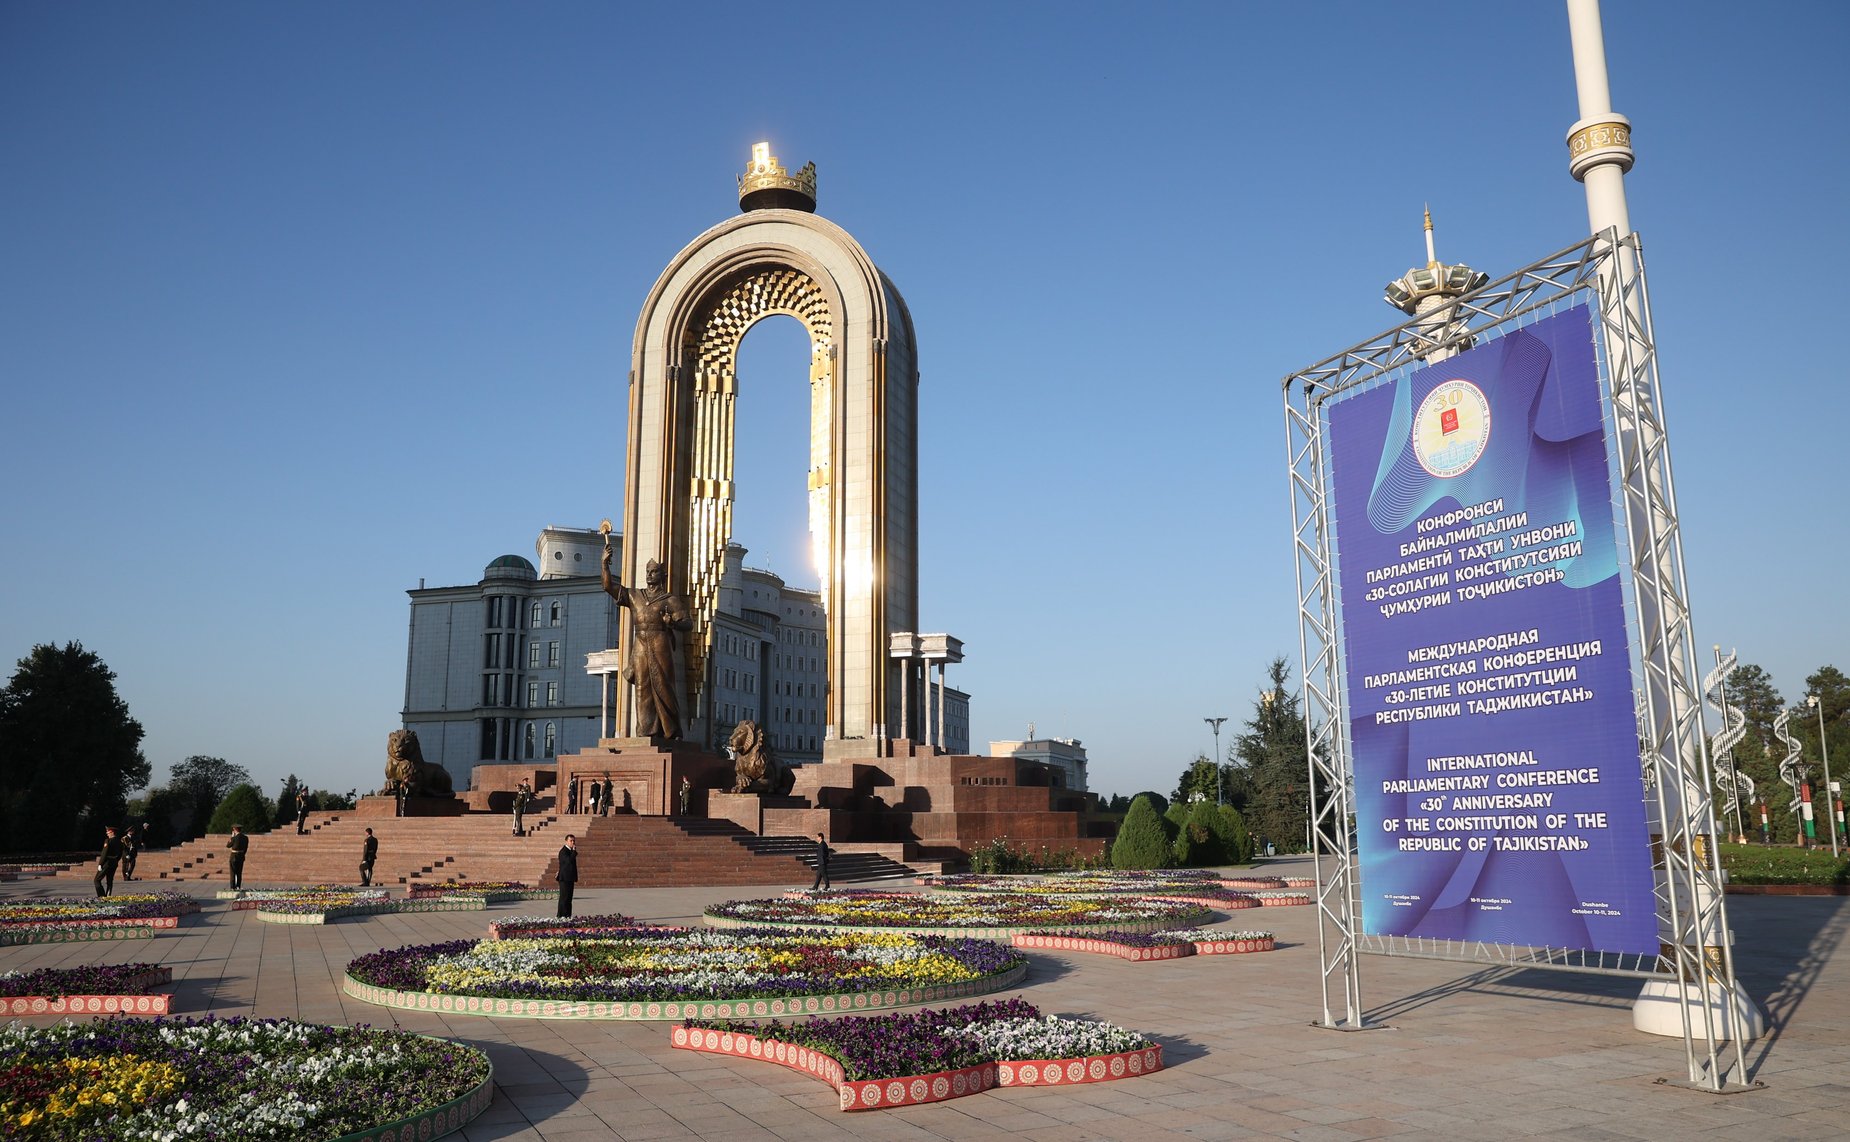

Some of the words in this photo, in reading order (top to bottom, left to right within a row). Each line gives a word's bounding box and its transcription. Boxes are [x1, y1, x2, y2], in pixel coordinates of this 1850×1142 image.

[1433, 389, 1463, 412] 30
[1417, 498, 1504, 534] КОНФРОНСИ
[1366, 549, 1453, 584] ПАРЛАМЕНТӢ
[1458, 538, 1504, 561] ТАҲТИ
[1510, 520, 1576, 551] УНВОНИ
[1400, 512, 1528, 557] БАЙНАЛМИЛАЛИИ
[1365, 571, 1449, 602] «30-СОЛАГИИ
[1455, 541, 1582, 583] КОНСТИТУТСИЯИ
[1380, 591, 1451, 619] ҶУМҲУРИИ
[1456, 568, 1565, 602] ТОҶИКИСТОН»
[1407, 628, 1539, 664] МЕЖДУНАРОДНАЯ
[1364, 659, 1477, 689] ПАРЛАМЕНТСКАЯ
[1483, 640, 1602, 672] КОНФЕРЕНЦИЯ
[1384, 683, 1452, 705] «30-ЛЕТИЕ
[1457, 666, 1577, 696] КОНСТИТУТЦИИ
[1375, 702, 1461, 725] РЕСПУБЛИКИ
[1466, 687, 1594, 715] ТАДЖИКИСТАН»
[1427, 750, 1538, 772] INTERNATIONAL
[1382, 775, 1490, 794] PARLIAMENTARY
[1496, 768, 1600, 788] CONFERENCE
[1452, 793, 1553, 811] ANNIVERSARY
[1382, 818, 1400, 832] OF
[1405, 818, 1430, 832] THE
[1436, 815, 1538, 831] CONSTITUTION
[1545, 814, 1567, 829] OF
[1574, 813, 1608, 828] THE
[1399, 837, 1462, 851] REPUBLIC
[1468, 837, 1487, 851] OF
[1494, 836, 1589, 851] TAJIKISTAN»
